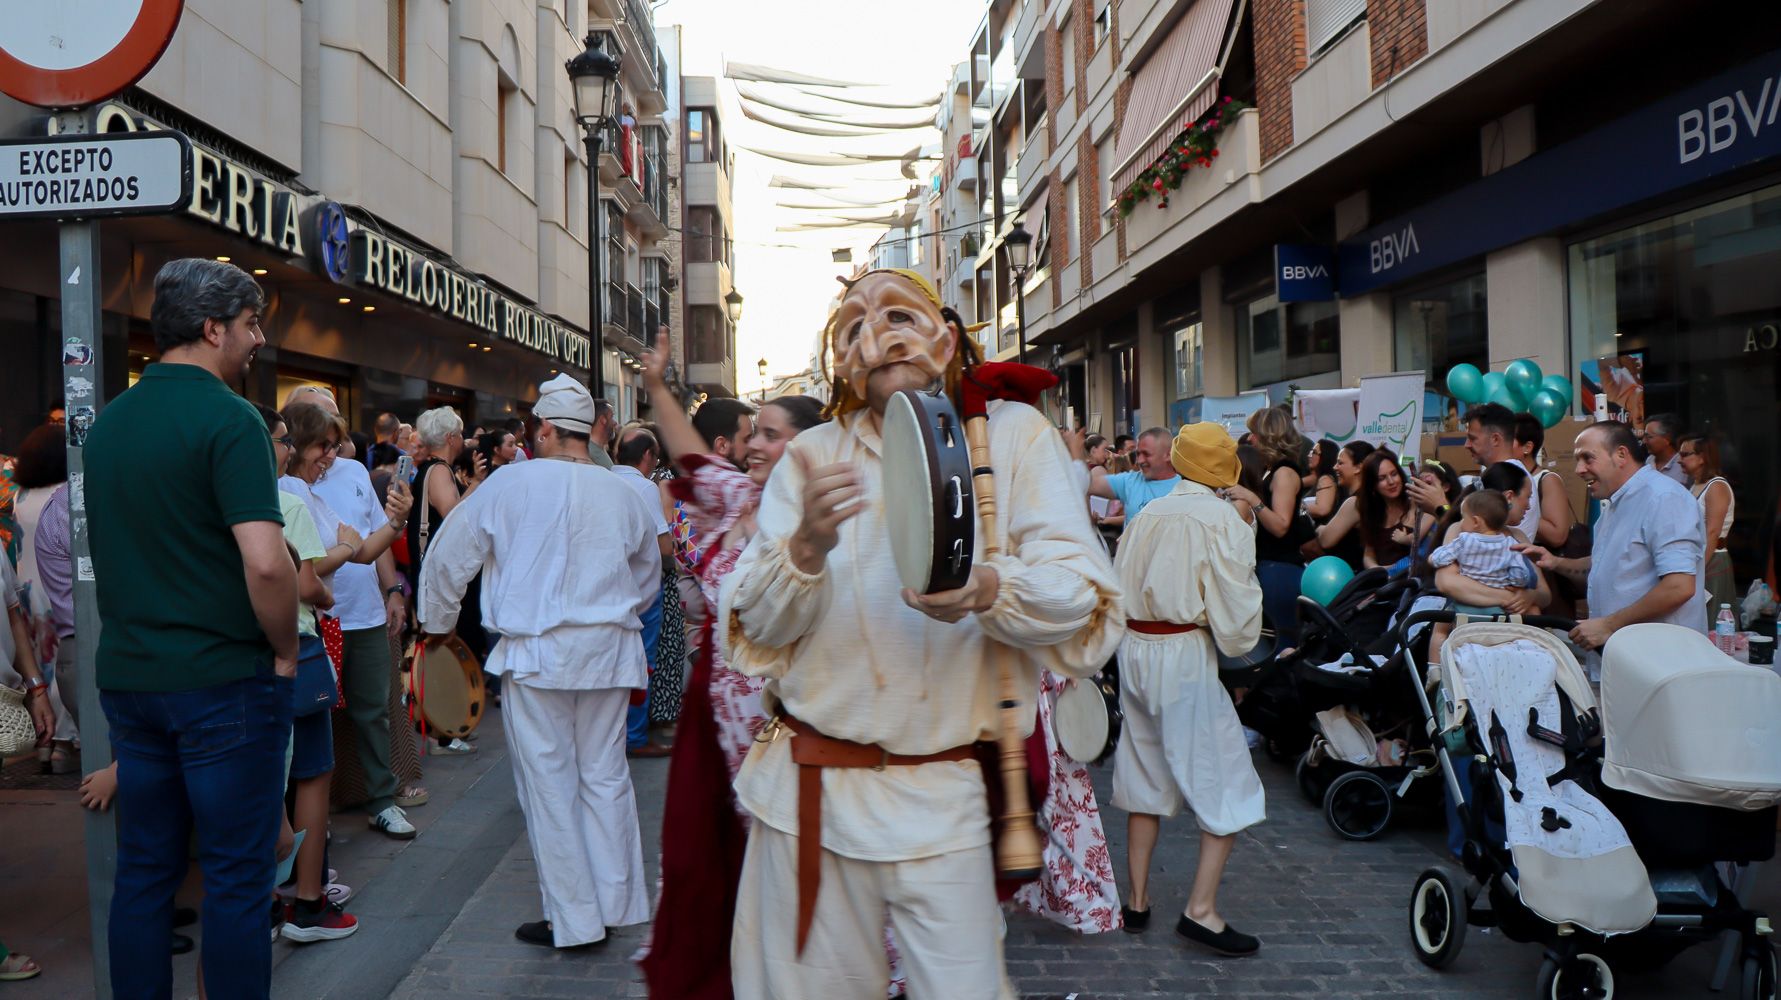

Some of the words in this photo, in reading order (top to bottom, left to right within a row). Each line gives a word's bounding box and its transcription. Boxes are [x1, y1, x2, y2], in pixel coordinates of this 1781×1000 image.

[20, 147, 113, 175] EXCEPTO
[1370, 221, 1420, 274] BBVA
[1283, 264, 1328, 280] BBVA
[364, 231, 498, 332] RELOJERIA
[505, 301, 560, 357] ROLDAN
[564, 330, 590, 368] OPTI
